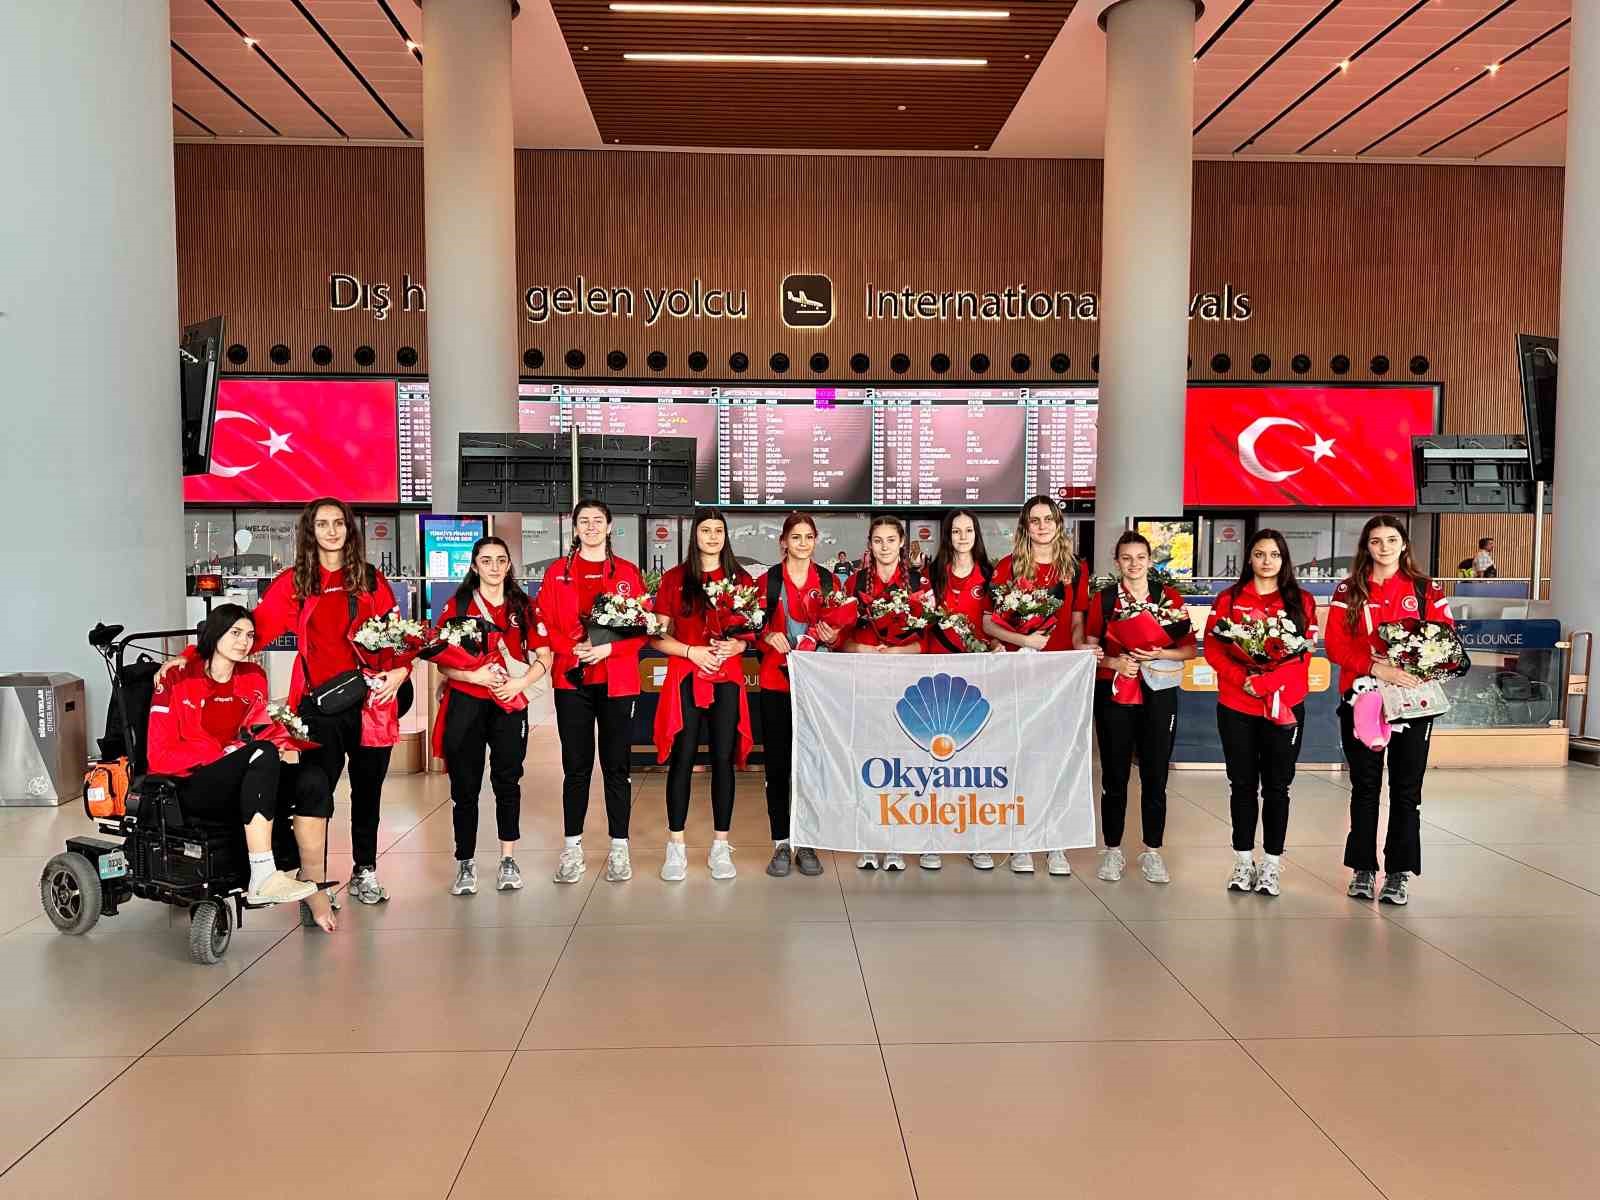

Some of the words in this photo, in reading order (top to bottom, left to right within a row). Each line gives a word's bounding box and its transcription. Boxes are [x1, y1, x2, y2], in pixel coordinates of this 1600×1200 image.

[330, 273, 391, 320] Dış
[525, 275, 633, 323] gelen
[644, 278, 748, 326] yolcu
[865, 282, 1098, 322] Internationa
[1477, 633, 1523, 645] LOUNGE
[861, 757, 1008, 797] Okyanus
[879, 792, 1026, 833] Kolejleri
